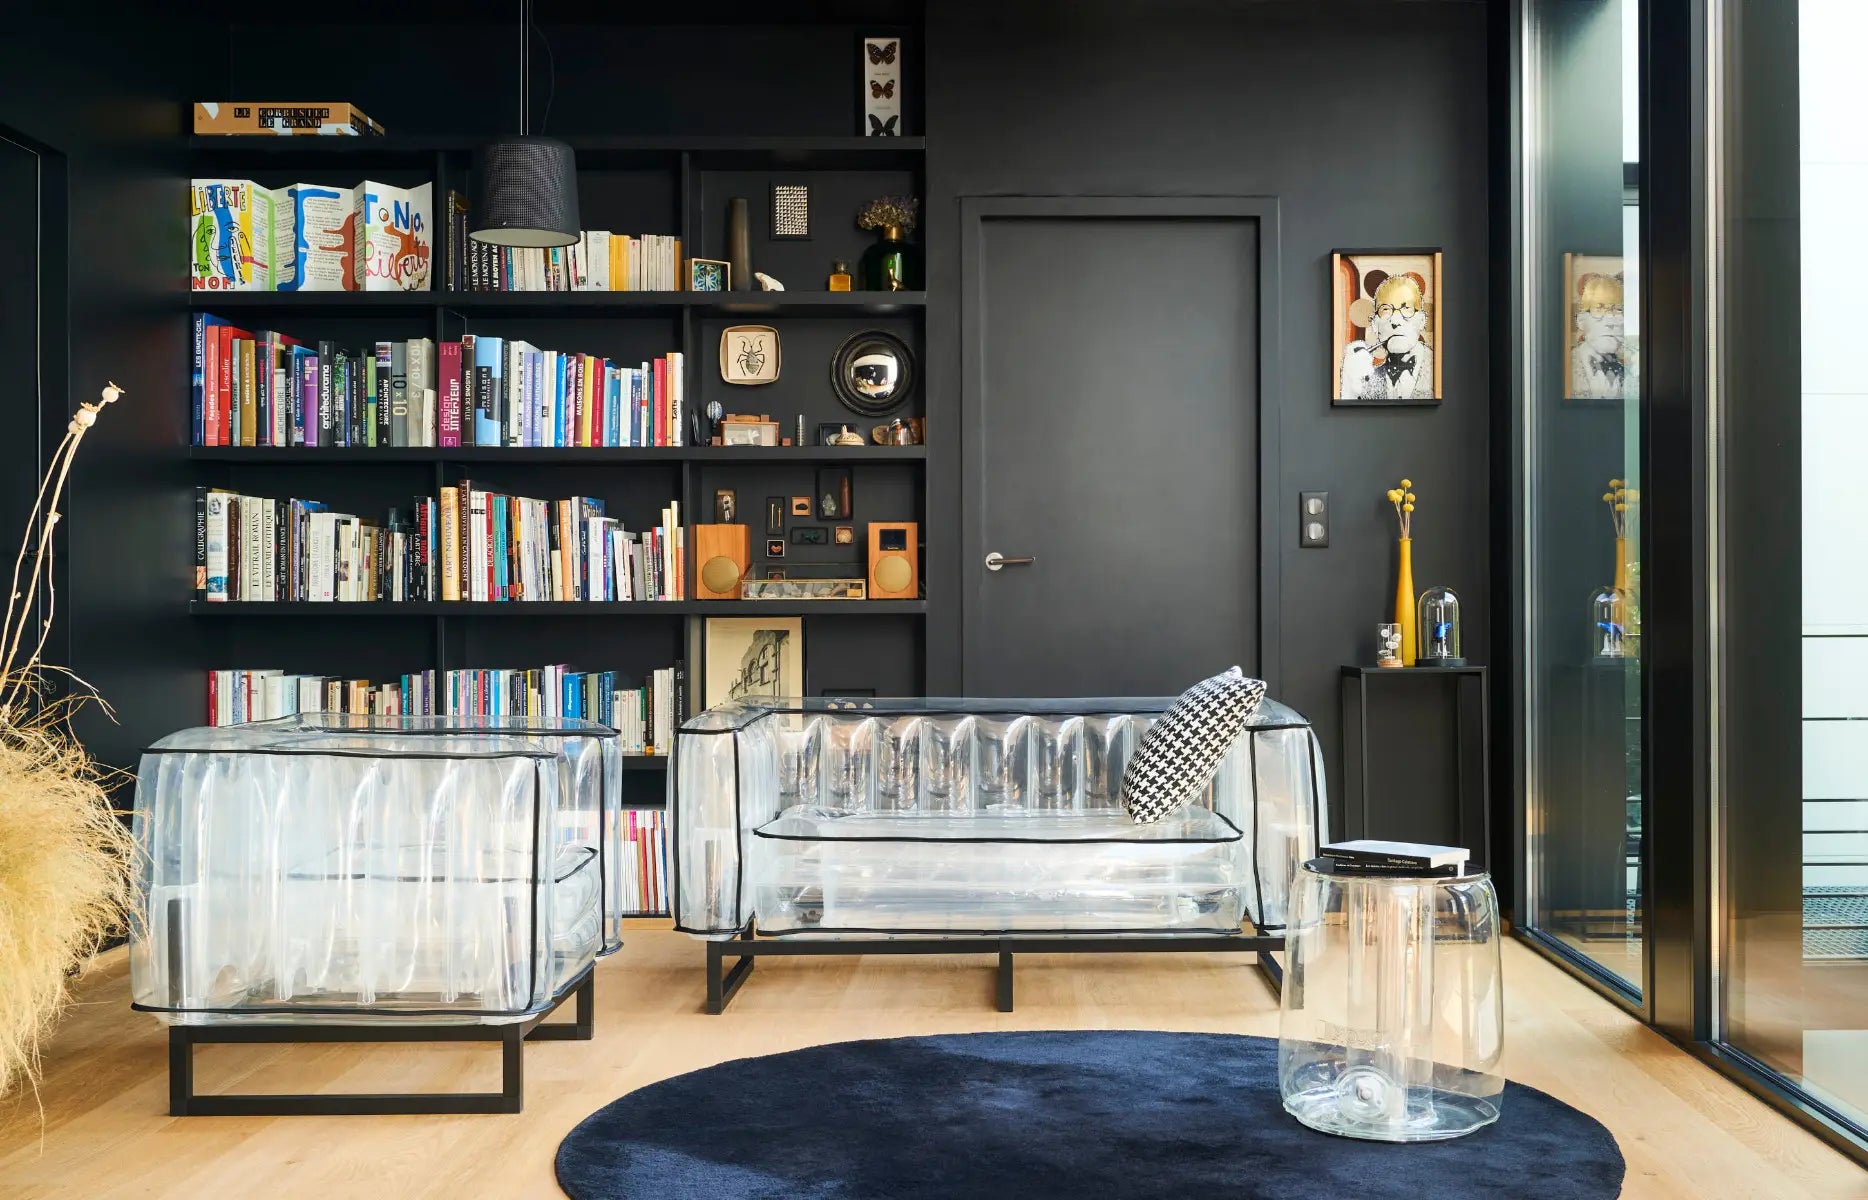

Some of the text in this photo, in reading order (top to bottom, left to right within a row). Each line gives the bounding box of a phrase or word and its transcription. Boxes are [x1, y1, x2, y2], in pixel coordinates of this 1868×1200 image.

[234, 108, 329, 118] LE CORBUSIER
[259, 118, 321, 128] LE GRAND
[393, 373, 407, 389] 10
[578, 378, 583, 387] EN
[319, 365, 329, 429] architecturama
[393, 400, 407, 415] 10
[441, 395, 450, 431] design
[197, 511, 205, 560] CALLIGRAPHIE
[252, 578, 260, 587] LE
